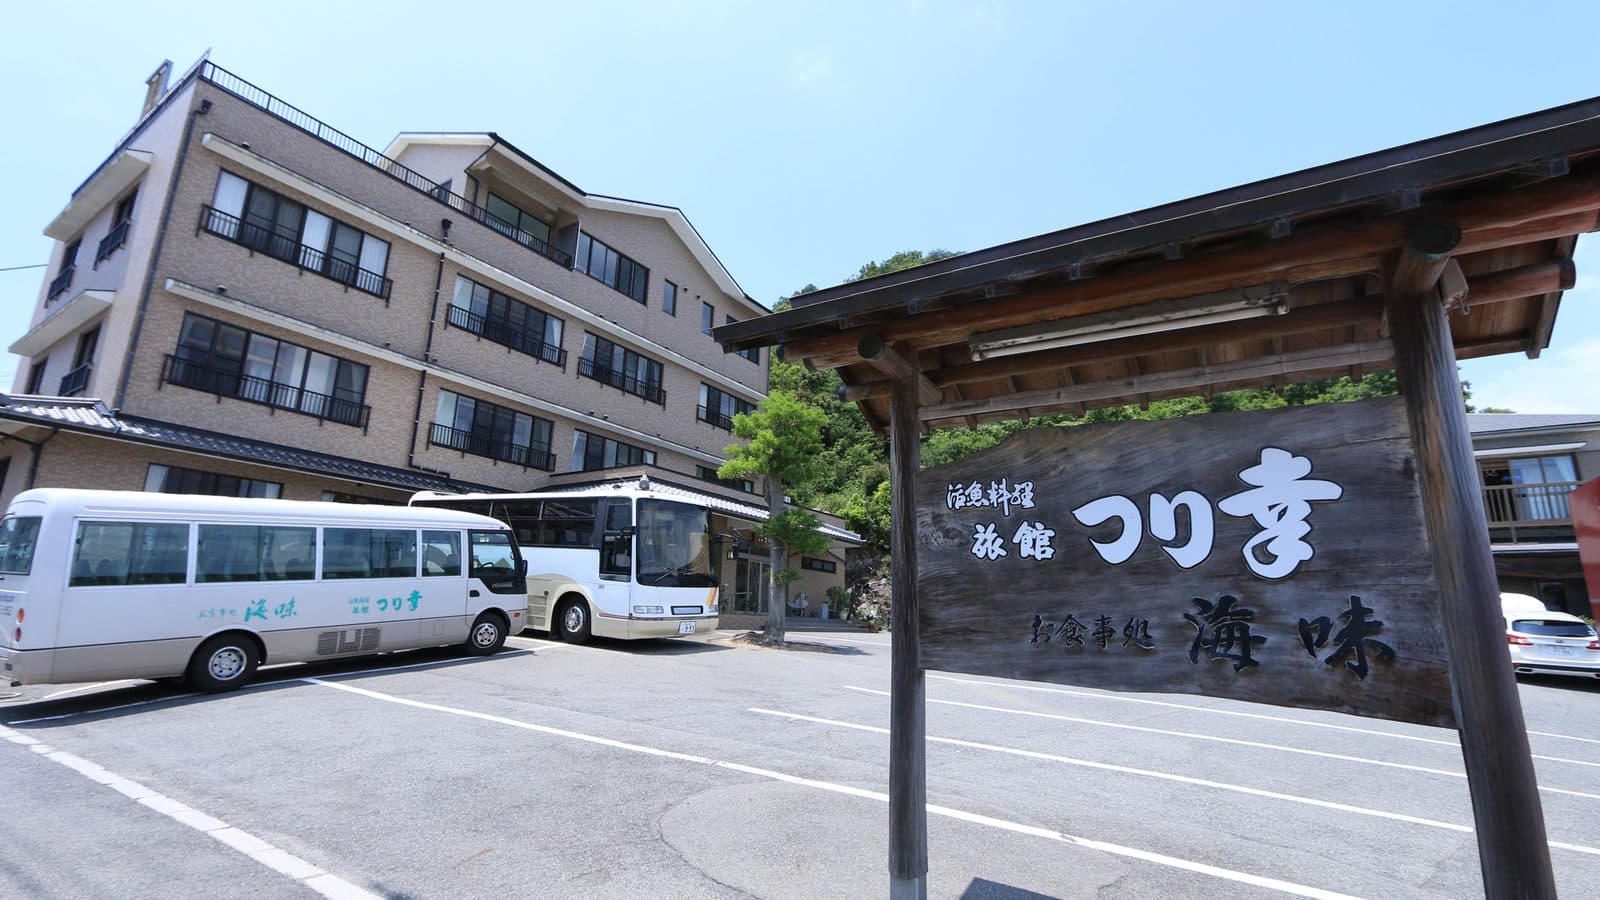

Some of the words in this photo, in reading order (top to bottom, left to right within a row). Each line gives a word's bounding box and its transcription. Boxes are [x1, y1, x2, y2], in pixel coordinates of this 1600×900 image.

[946, 478, 1035, 517] 活魚料理
[1071, 447, 1344, 580] つり幸
[971, 520, 1056, 561] 旅館
[1029, 613, 1154, 649] お食事処
[1183, 595, 1396, 680] 海味
